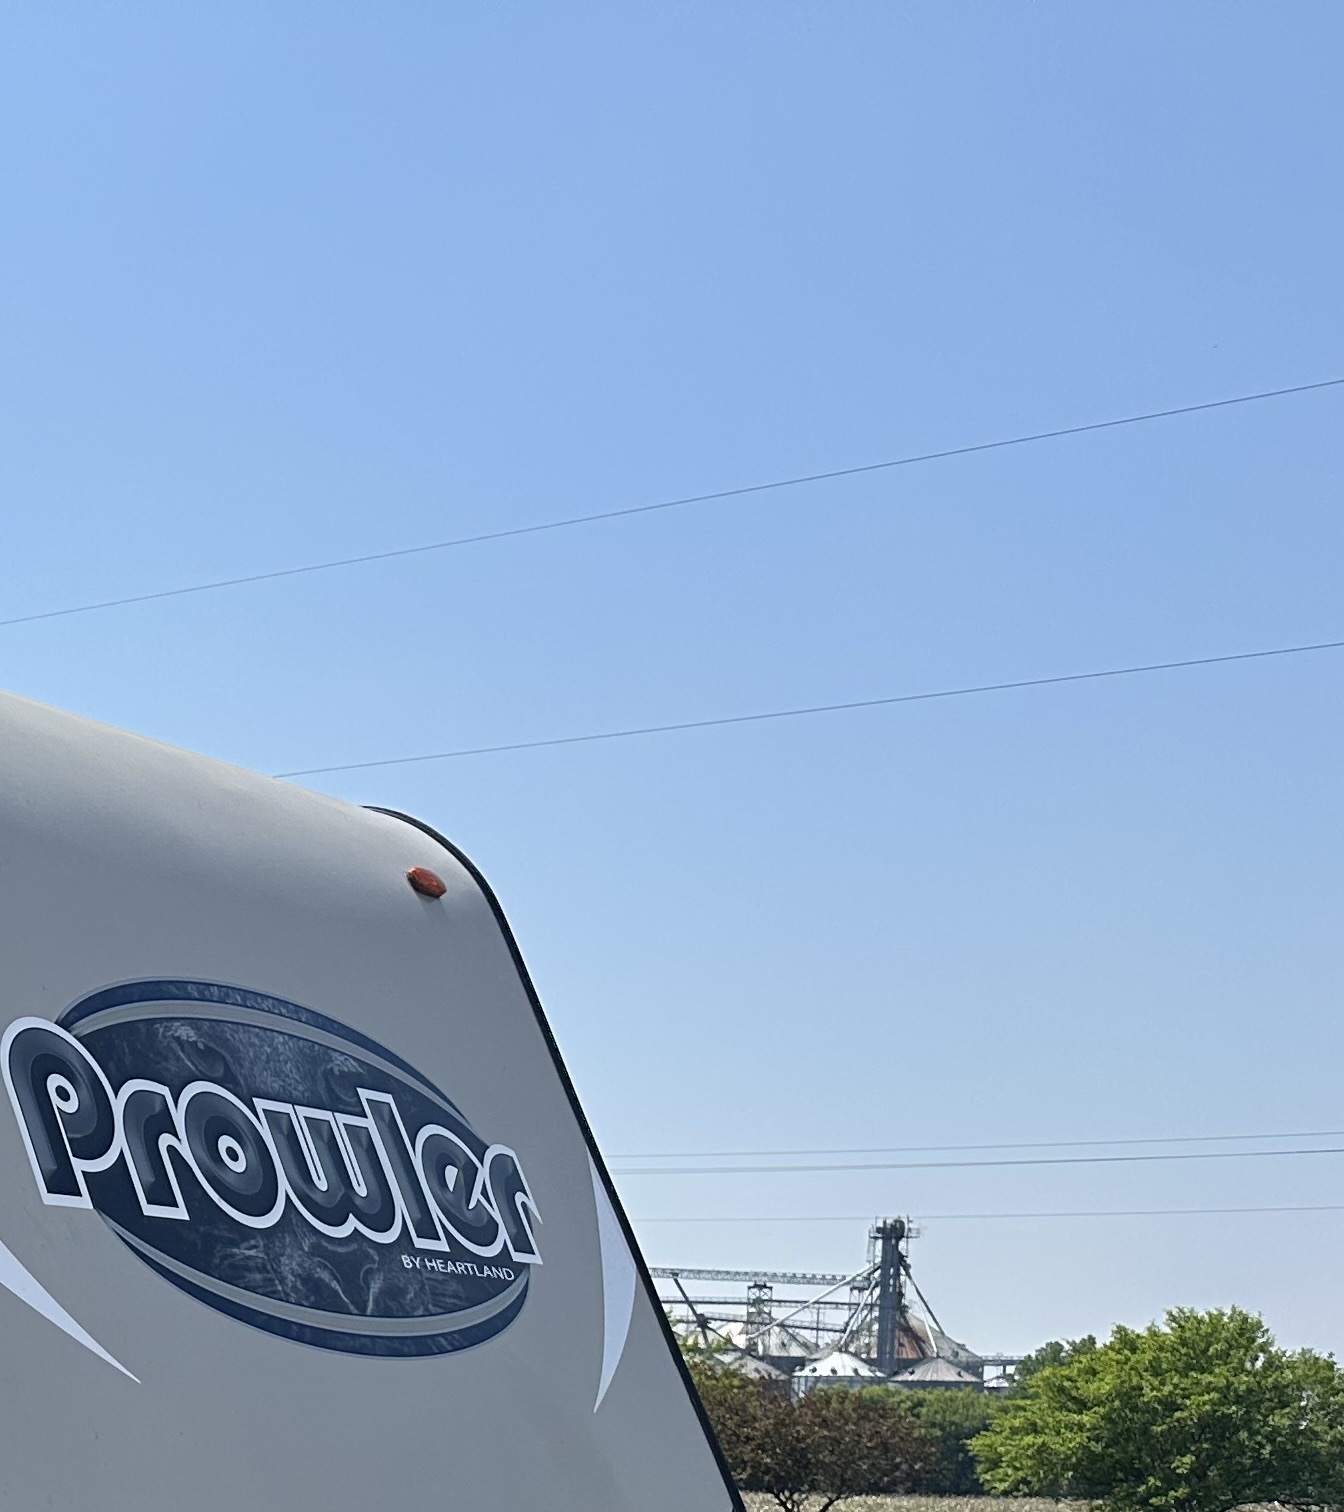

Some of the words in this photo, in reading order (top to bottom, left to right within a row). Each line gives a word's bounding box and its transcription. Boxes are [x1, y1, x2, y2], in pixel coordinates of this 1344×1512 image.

[0, 1016, 543, 1265] Prowler
[401, 1254, 421, 1269] BY
[425, 1258, 515, 1281] HEARTLAND
